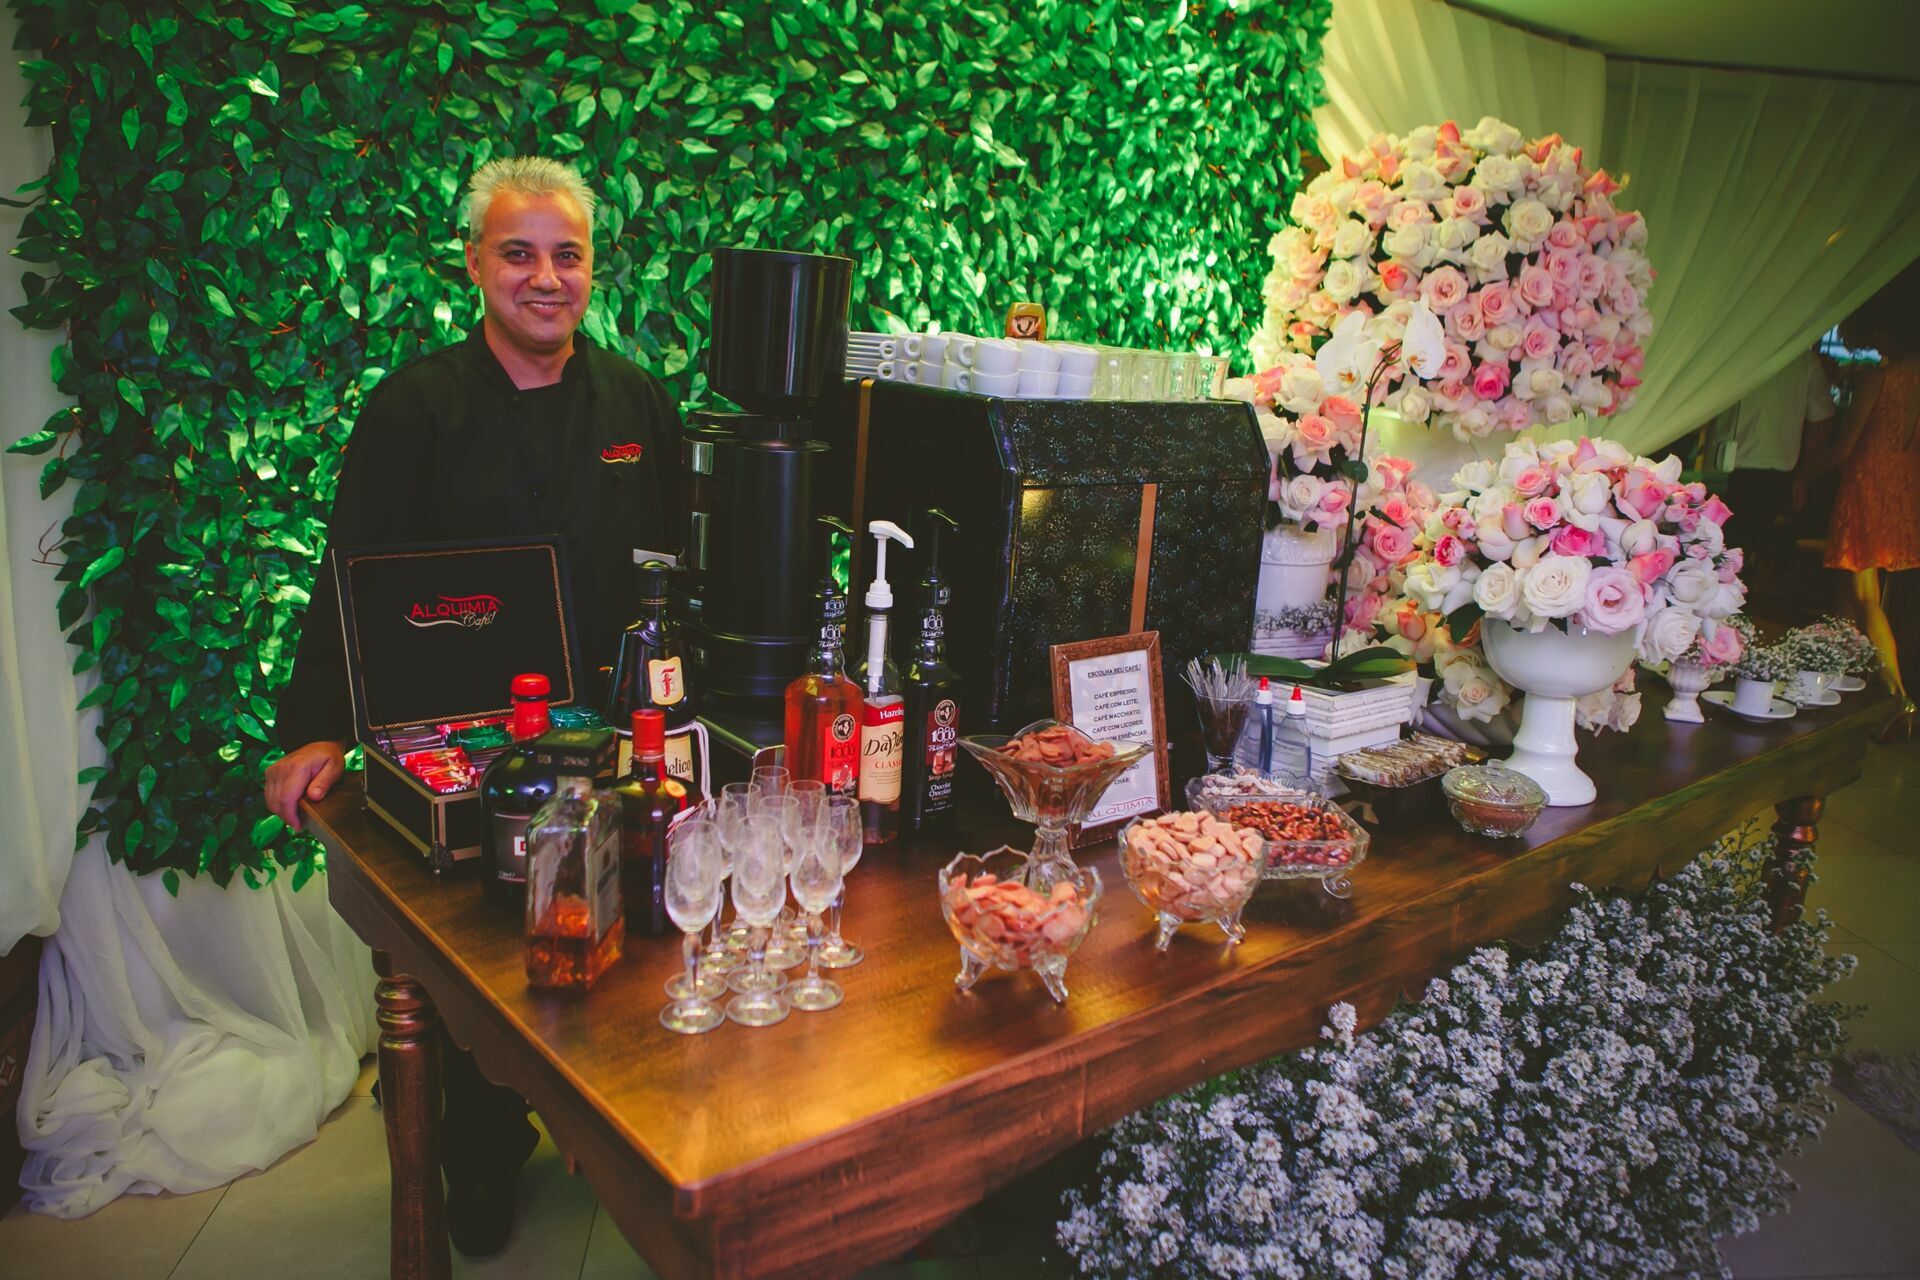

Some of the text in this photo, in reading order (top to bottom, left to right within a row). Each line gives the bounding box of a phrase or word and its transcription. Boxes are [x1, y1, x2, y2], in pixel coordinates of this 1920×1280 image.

[411, 601, 499, 619] ALQUIMIA
[1087, 670, 1113, 678] ESCOLHA
[1094, 692, 1109, 700] CAFÉ
[1095, 703, 1109, 711] CAFÉ
[1094, 714, 1108, 722] CAFÉ
[1092, 725, 1107, 734] CAFÉ
[1107, 723, 1120, 731] COM
[932, 726, 956, 743] 1883
